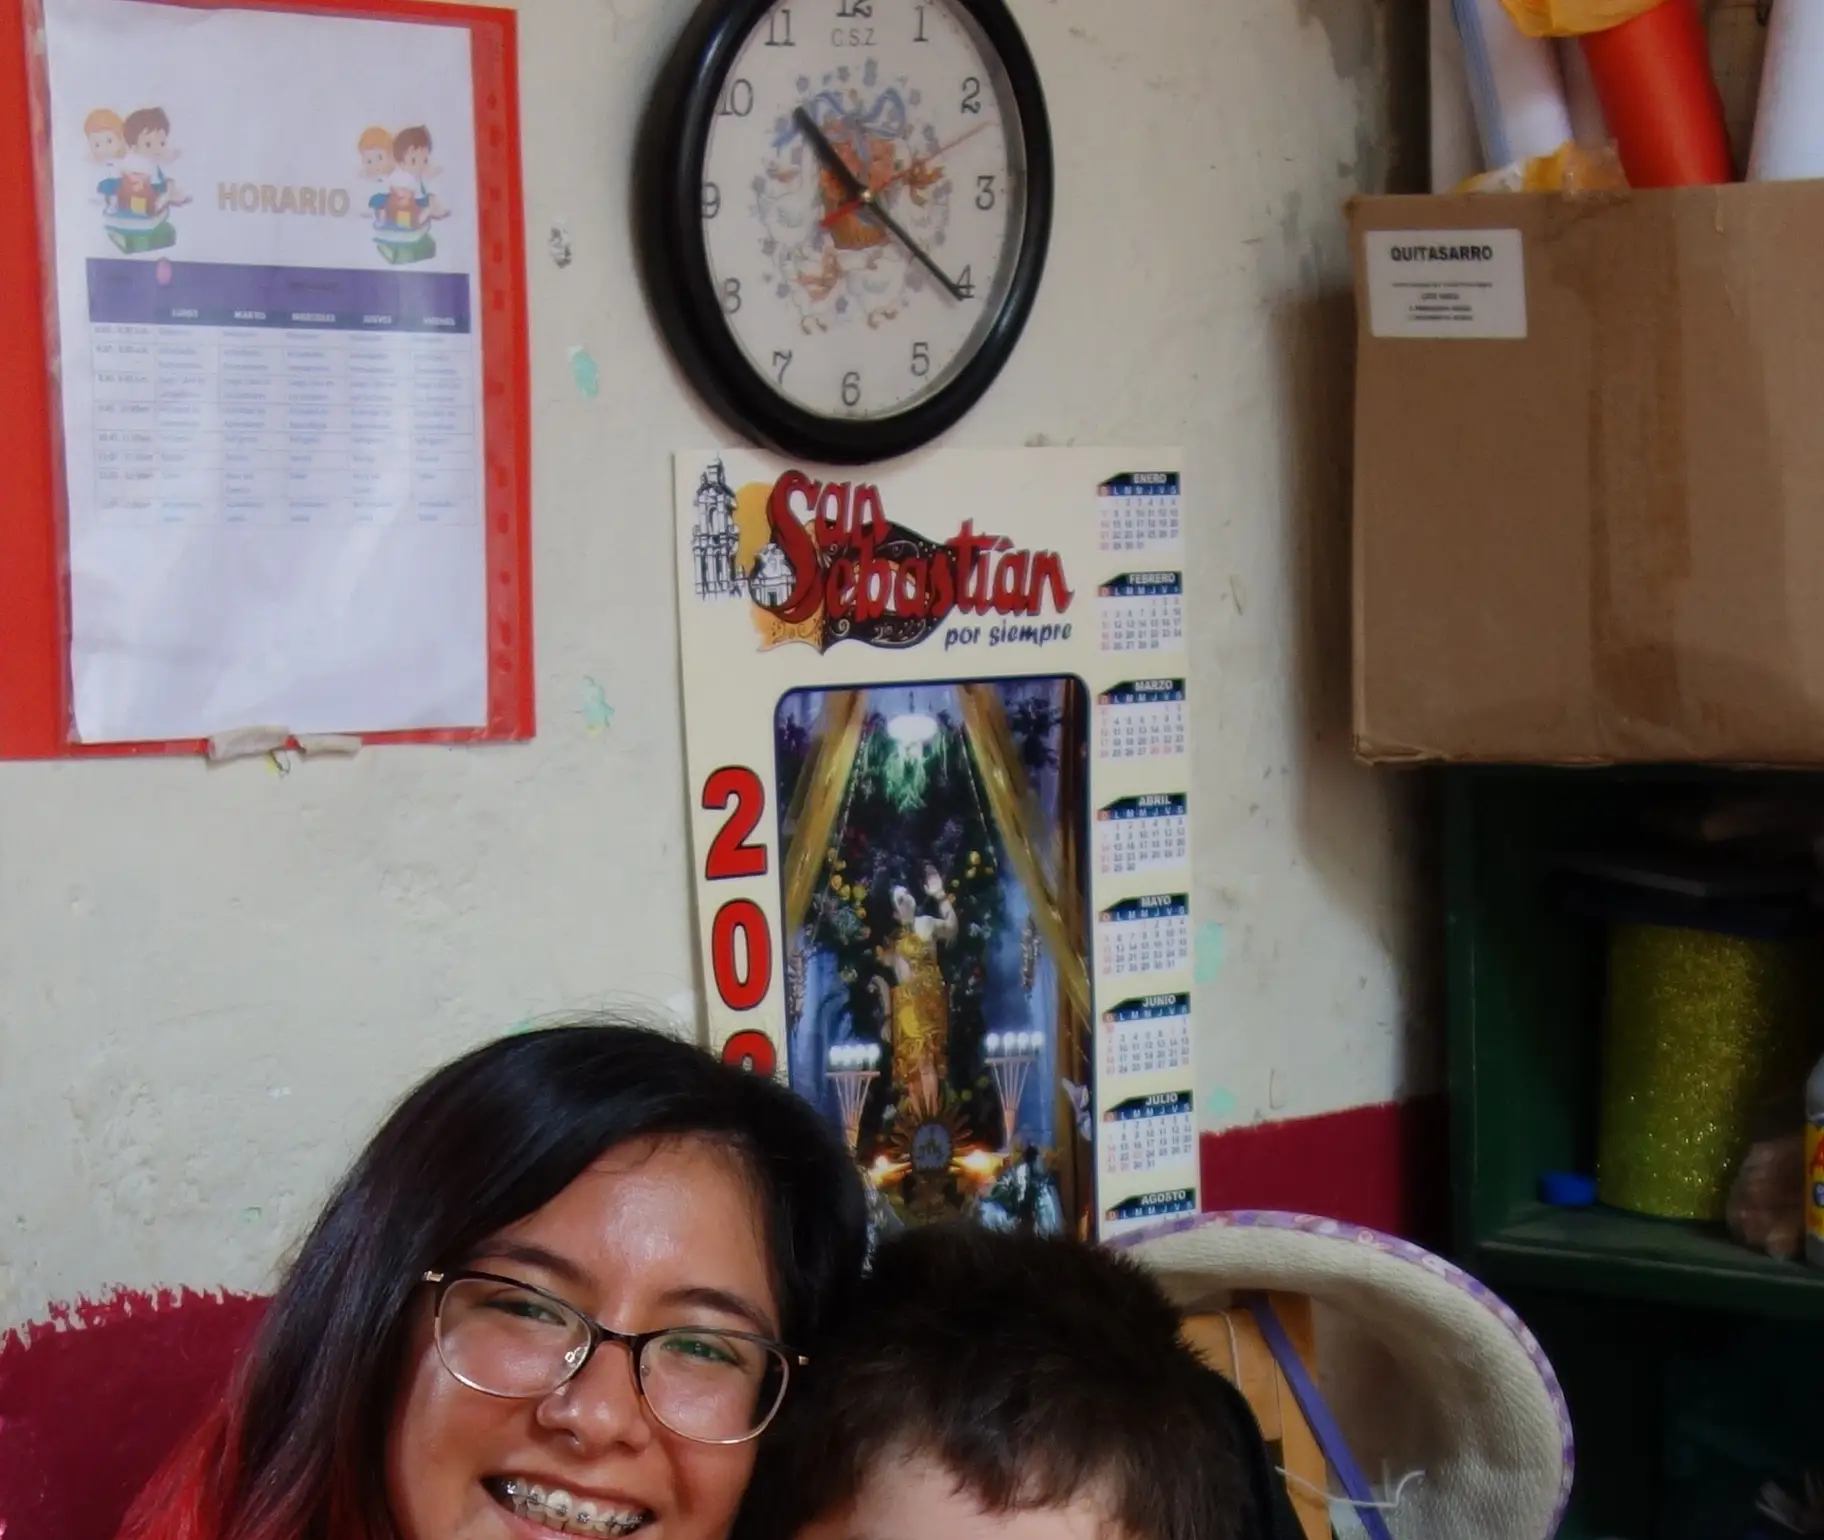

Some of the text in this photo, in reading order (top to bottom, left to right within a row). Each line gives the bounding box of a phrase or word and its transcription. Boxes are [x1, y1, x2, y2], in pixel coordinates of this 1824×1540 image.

[764, 9, 795, 46] 11
[912, 5, 929, 43] 1
[718, 78, 754, 118] 10
[961, 77, 982, 115] 2
[217, 181, 351, 218] HORARIO
[704, 182, 721, 219] 9
[976, 176, 996, 211] 3
[1390, 246, 1493, 261] QUITASARRO
[953, 265, 975, 300] 4
[772, 349, 793, 385] 7
[911, 342, 930, 377] 5
[841, 371, 861, 406] 6
[944, 627, 982, 651] por
[988, 619, 1073, 647] siempre
[1135, 680, 1173, 691] MARZO
[1141, 895, 1172, 908] MAYO
[1143, 995, 1176, 1008] JUNIO
[1145, 1093, 1178, 1106] JULIO
[1141, 1190, 1187, 1205] AGOSTO
